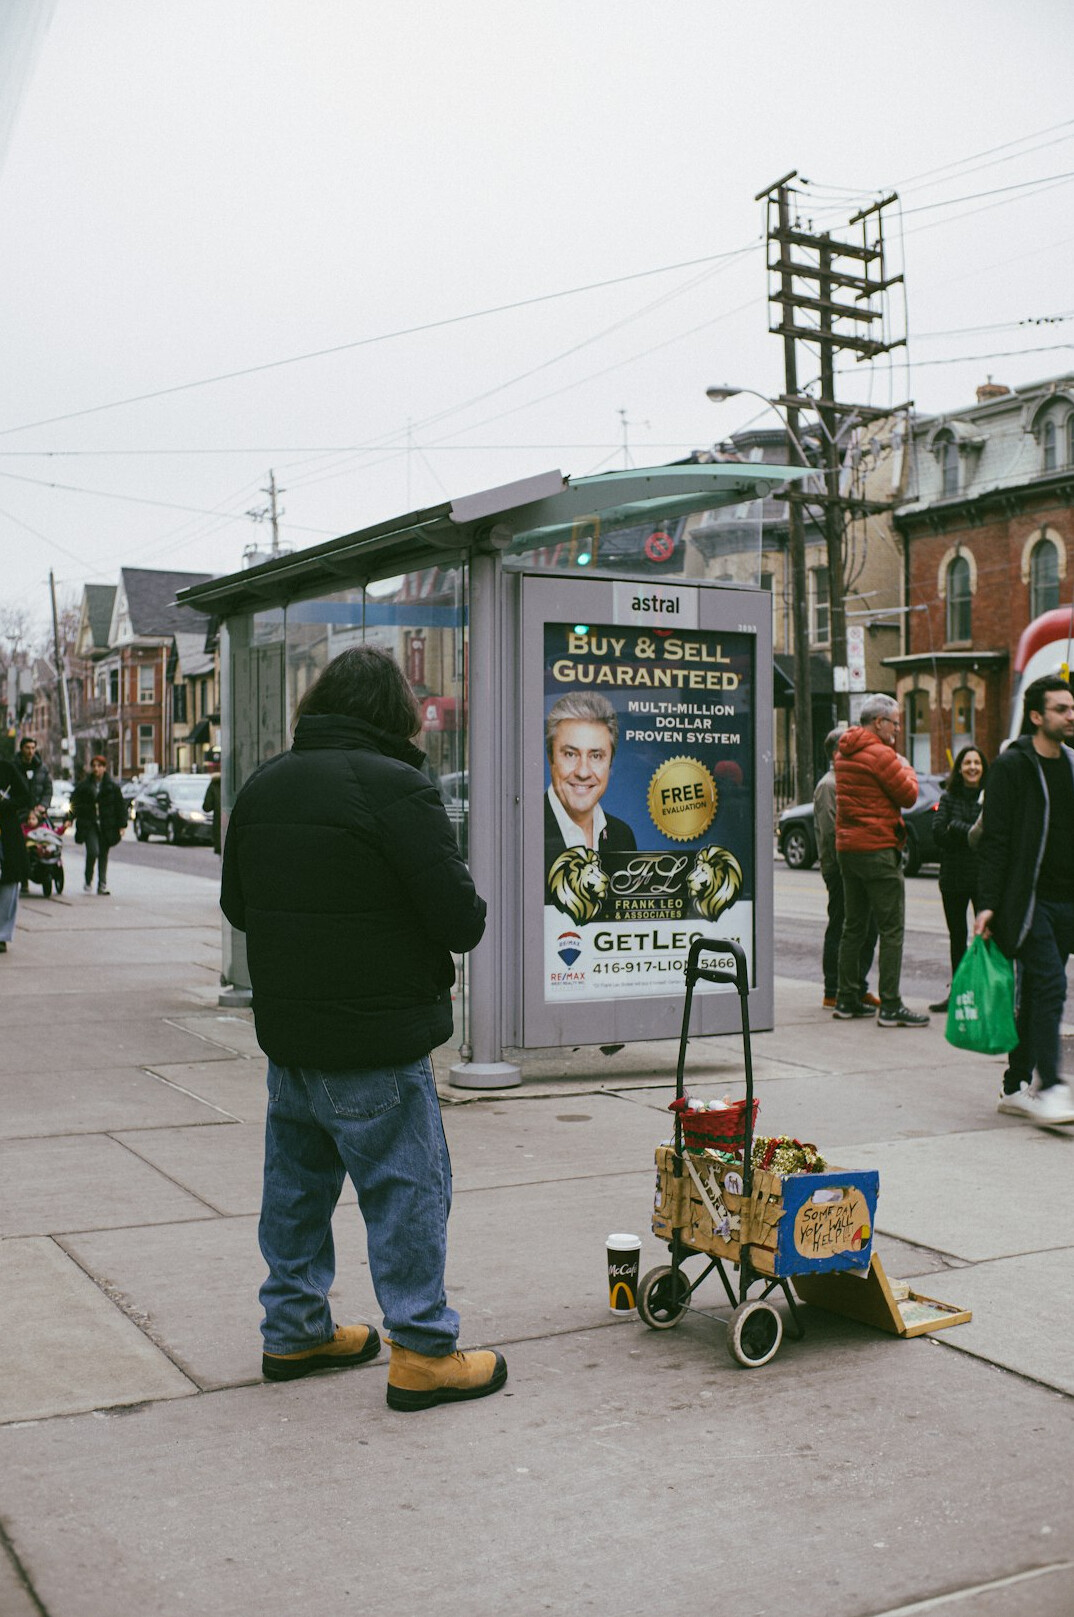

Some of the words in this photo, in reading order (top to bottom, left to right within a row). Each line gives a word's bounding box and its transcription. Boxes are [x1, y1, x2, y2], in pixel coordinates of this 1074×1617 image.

[631, 595, 679, 614] astral
[568, 632, 626, 657] BUY
[634, 637, 656, 659] &
[663, 638, 731, 664] SELL
[628, 701, 735, 716] MULTI-MILLION
[655, 716, 712, 730] DOLLAR
[625, 730, 683, 743] PROVEN
[686, 732, 741, 745] SYSTEM
[661, 783, 704, 805] FREE
[662, 801, 707, 816] EVALUATION
[615, 899, 655, 910] FRANK
[660, 898, 684, 910] LEO
[615, 911, 622, 920] &
[624, 910, 682, 919] ASSOCIATES
[550, 972, 586, 981] RE/MAX
[829, 1214, 854, 1232] WILL
